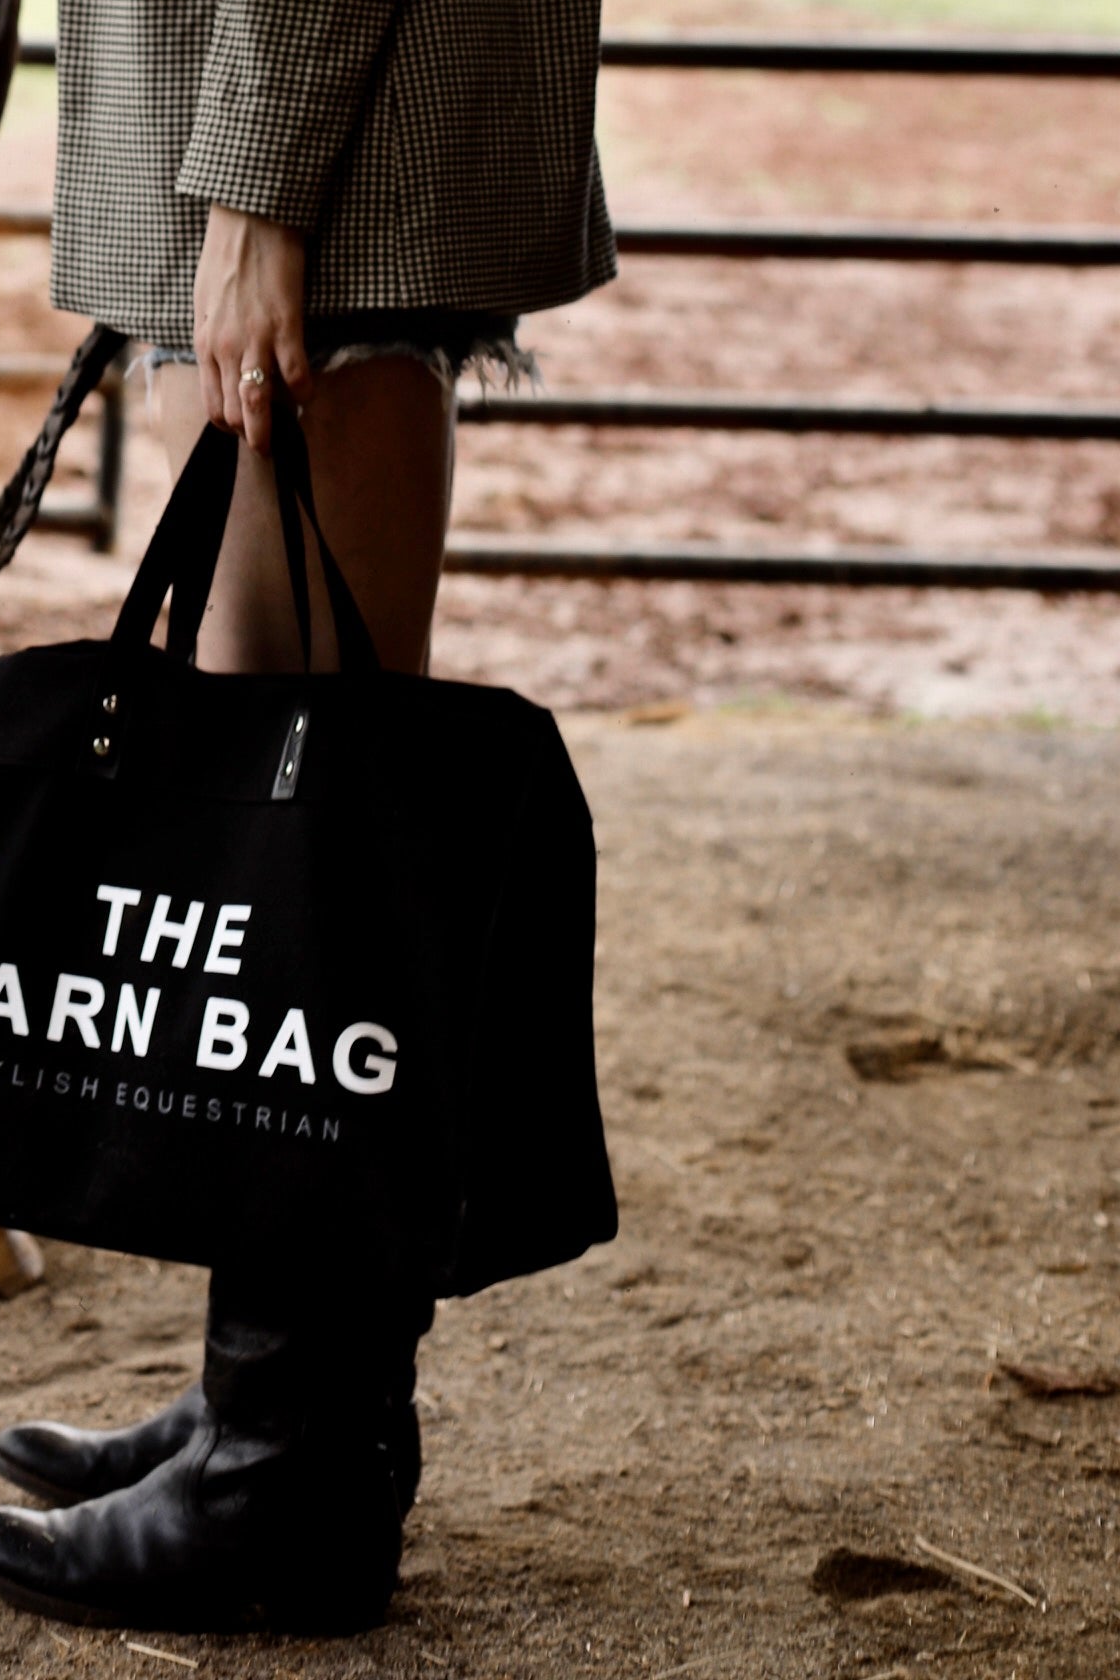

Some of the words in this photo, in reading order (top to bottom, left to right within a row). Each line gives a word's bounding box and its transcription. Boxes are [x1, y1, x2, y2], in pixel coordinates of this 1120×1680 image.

[97, 884, 252, 975] THE
[196, 996, 398, 1095] BAG
[114, 1082, 340, 1142] EQUESTRIAN
